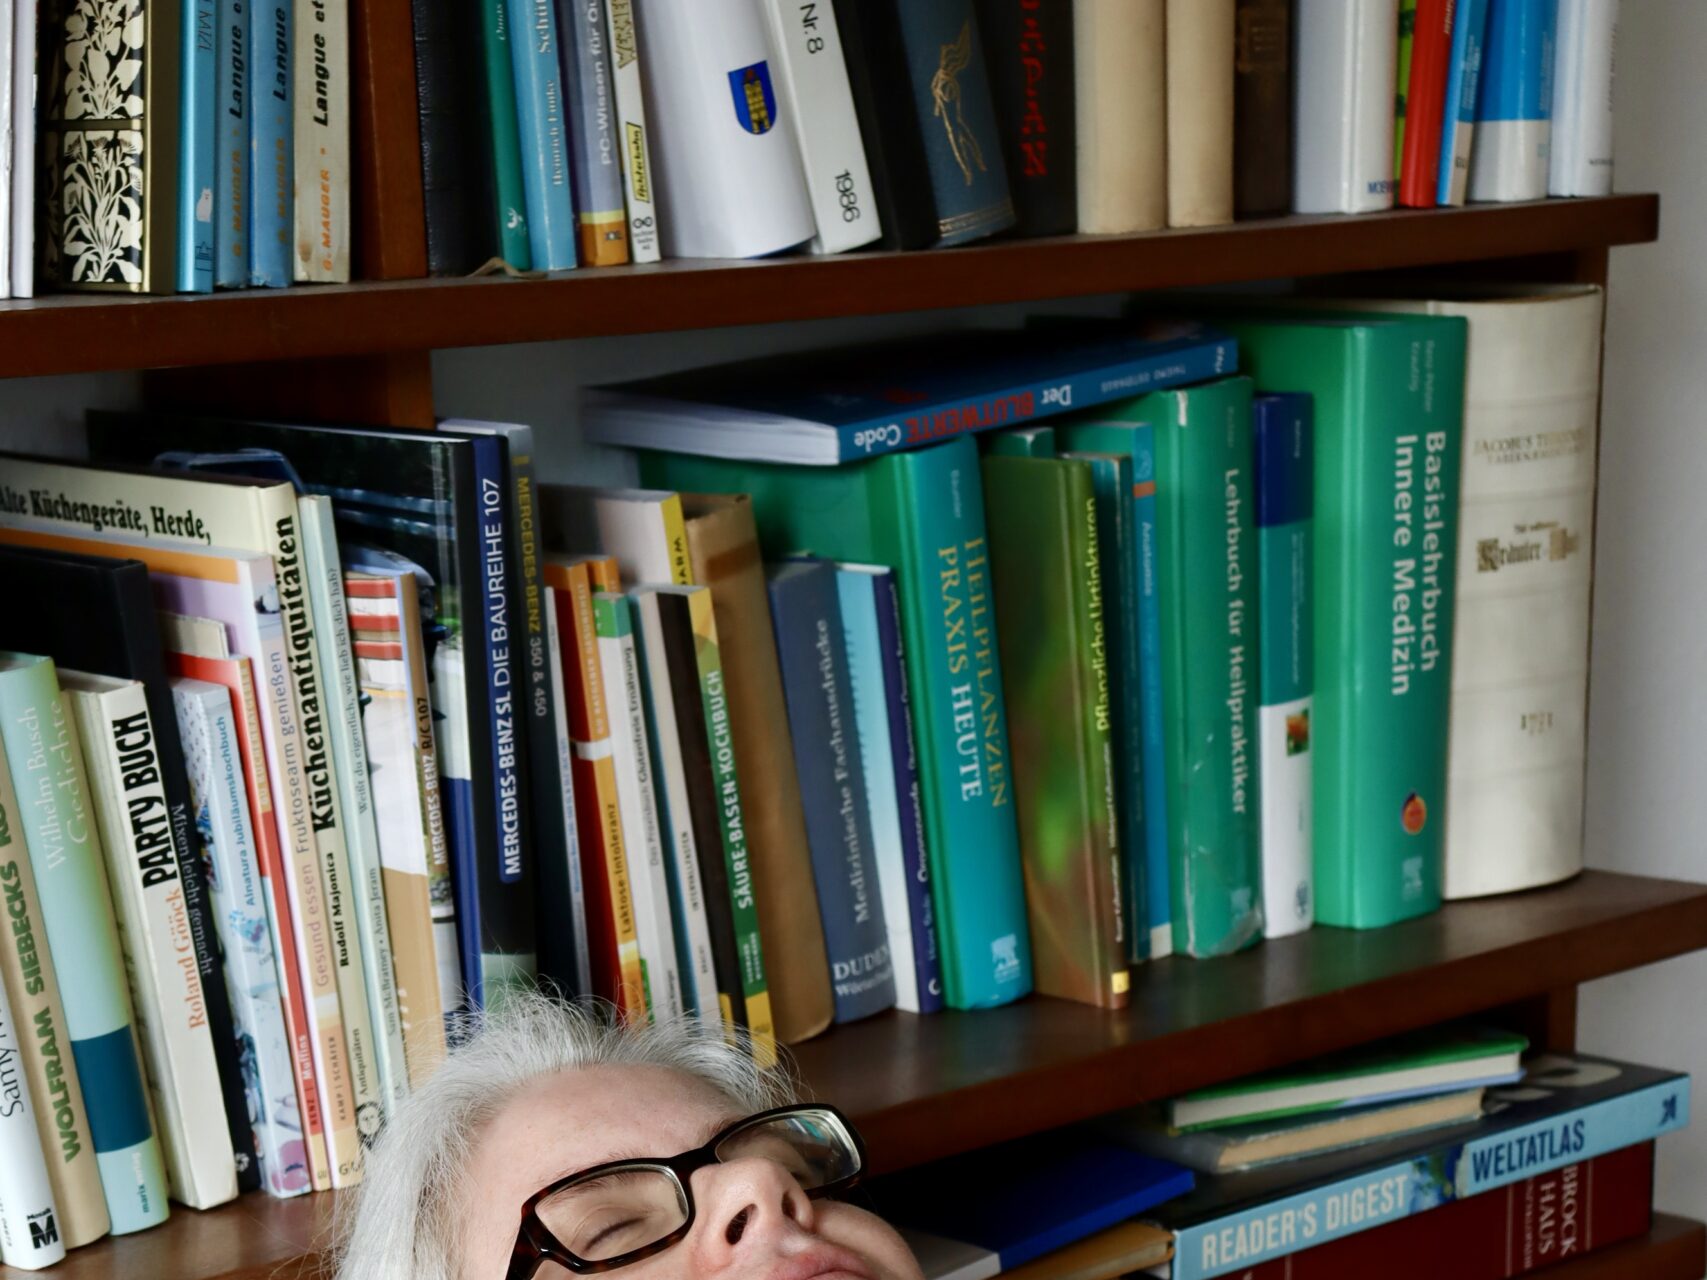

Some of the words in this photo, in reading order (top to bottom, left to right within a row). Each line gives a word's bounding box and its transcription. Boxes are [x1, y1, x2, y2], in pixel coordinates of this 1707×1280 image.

[228, 24, 244, 119] Langue
[272, 7, 288, 102] Langue
[313, 33, 330, 127] Langue
[807, 37, 825, 55] 8
[1018, 0, 1049, 176] APAN
[590, 64, 612, 165] PC-Wissen
[320, 169, 333, 251] MAUGER
[833, 168, 861, 223] 1986
[854, 424, 901, 452] Code
[905, 390, 1035, 443] BLUTWERTE
[1041, 385, 1072, 405] Der
[30, 489, 149, 538] Küchengeräte,
[150, 506, 212, 545] Herde,
[482, 478, 501, 518] 107
[1225, 469, 1244, 592] Lehrbuch
[1393, 434, 1418, 547] Innere
[485, 523, 510, 644] BAUREIHE
[517, 476, 540, 632] MERCEDES-BENZ
[1420, 431, 1446, 671] Basislehrbuch
[938, 546, 968, 674] PRAXIS
[1229, 598, 1245, 638] für
[1391, 558, 1416, 696] Medizin
[269, 651, 296, 737] genießen
[275, 515, 337, 833] Küchenantiquitäten
[415, 696, 429, 722] 107
[492, 646, 511, 689] DIE
[495, 692, 512, 715] SL
[817, 618, 849, 783] Fachausdrücke
[965, 537, 1008, 808] HEILPFLANZEN
[17, 705, 48, 773] Busch
[111, 710, 160, 792] BUCH
[952, 684, 983, 801] HEUTE
[1227, 645, 1249, 815] Heilpraktiker
[34, 774, 67, 870] Wilhelm
[215, 715, 247, 847] Jubiläumskochbuch
[284, 741, 312, 854] Fruktosearm
[422, 753, 448, 866] MERCEDES-BENZ
[497, 717, 522, 876] MERCEDES-BENZ
[706, 670, 752, 910] SÄURE-BASEN-KOCHBUCH
[128, 795, 178, 889] PARTY
[171, 802, 189, 858] Mixen
[182, 859, 201, 906] leicht
[236, 849, 256, 906] Alnatura
[302, 862, 320, 916] essen
[323, 852, 343, 917] Majonica
[608, 803, 632, 935] Laktose-Intoleranz
[839, 786, 870, 924] Medizinische
[0, 860, 45, 997] SIEBECKS
[307, 922, 328, 989] Gesund
[334, 918, 350, 968] Rudolf
[177, 956, 206, 1030] Roland
[33, 1006, 82, 1164] WOLFRAM
[298, 1034, 312, 1081] Muffins
[352, 1027, 369, 1097] Antiquitäten
[1471, 1118, 1586, 1184] WELTATLAS
[1201, 1203, 1318, 1272] READER'S
[1325, 1173, 1409, 1232] DIGEST
[1537, 1180, 1558, 1255] HAUS
[1558, 1165, 1580, 1258] BROCK
